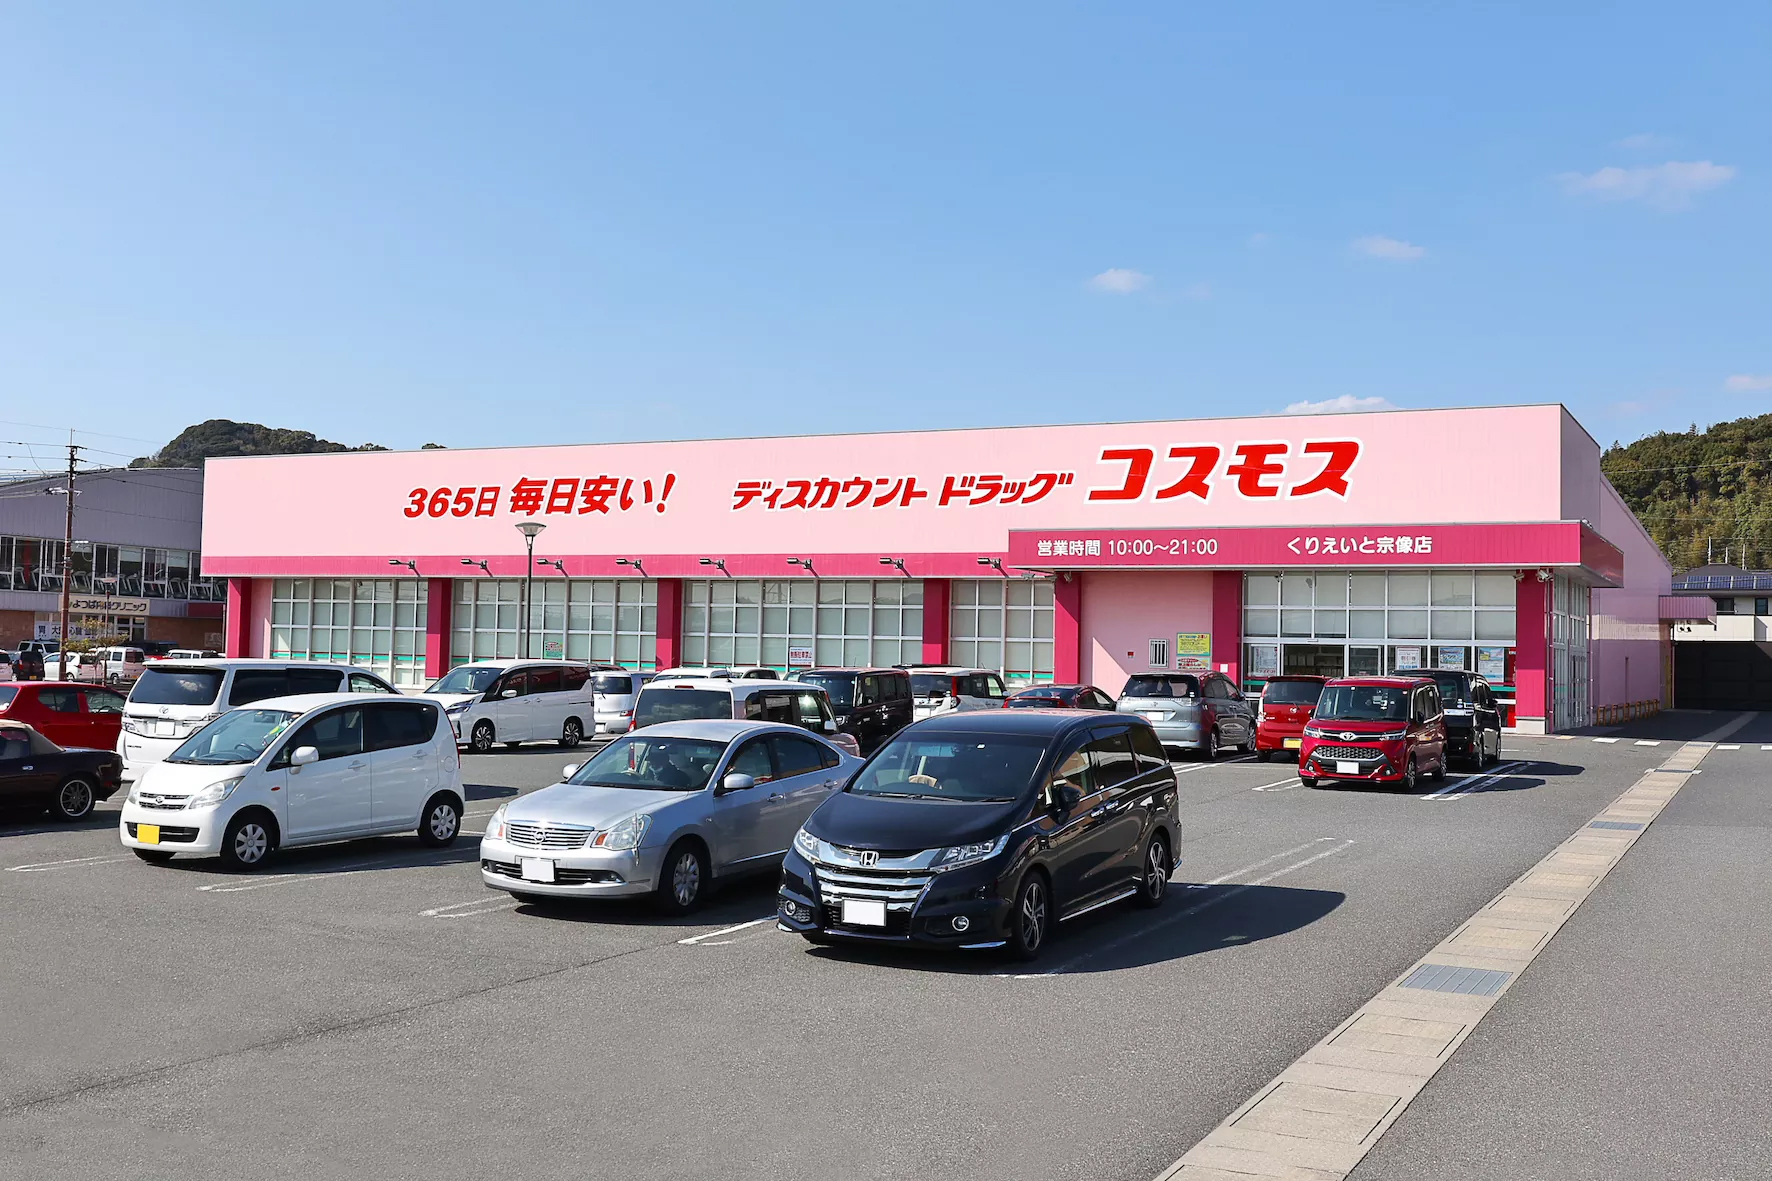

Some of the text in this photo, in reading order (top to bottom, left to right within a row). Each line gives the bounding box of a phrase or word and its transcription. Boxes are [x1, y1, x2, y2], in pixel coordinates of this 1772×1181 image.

[733, 440, 1361, 510] ディスカウント ドラッグ コスモス
[404, 485, 502, 519] 365日
[1036, 538, 1101, 557] 営業時間
[1286, 534, 1434, 556] くりえいと宗像店
